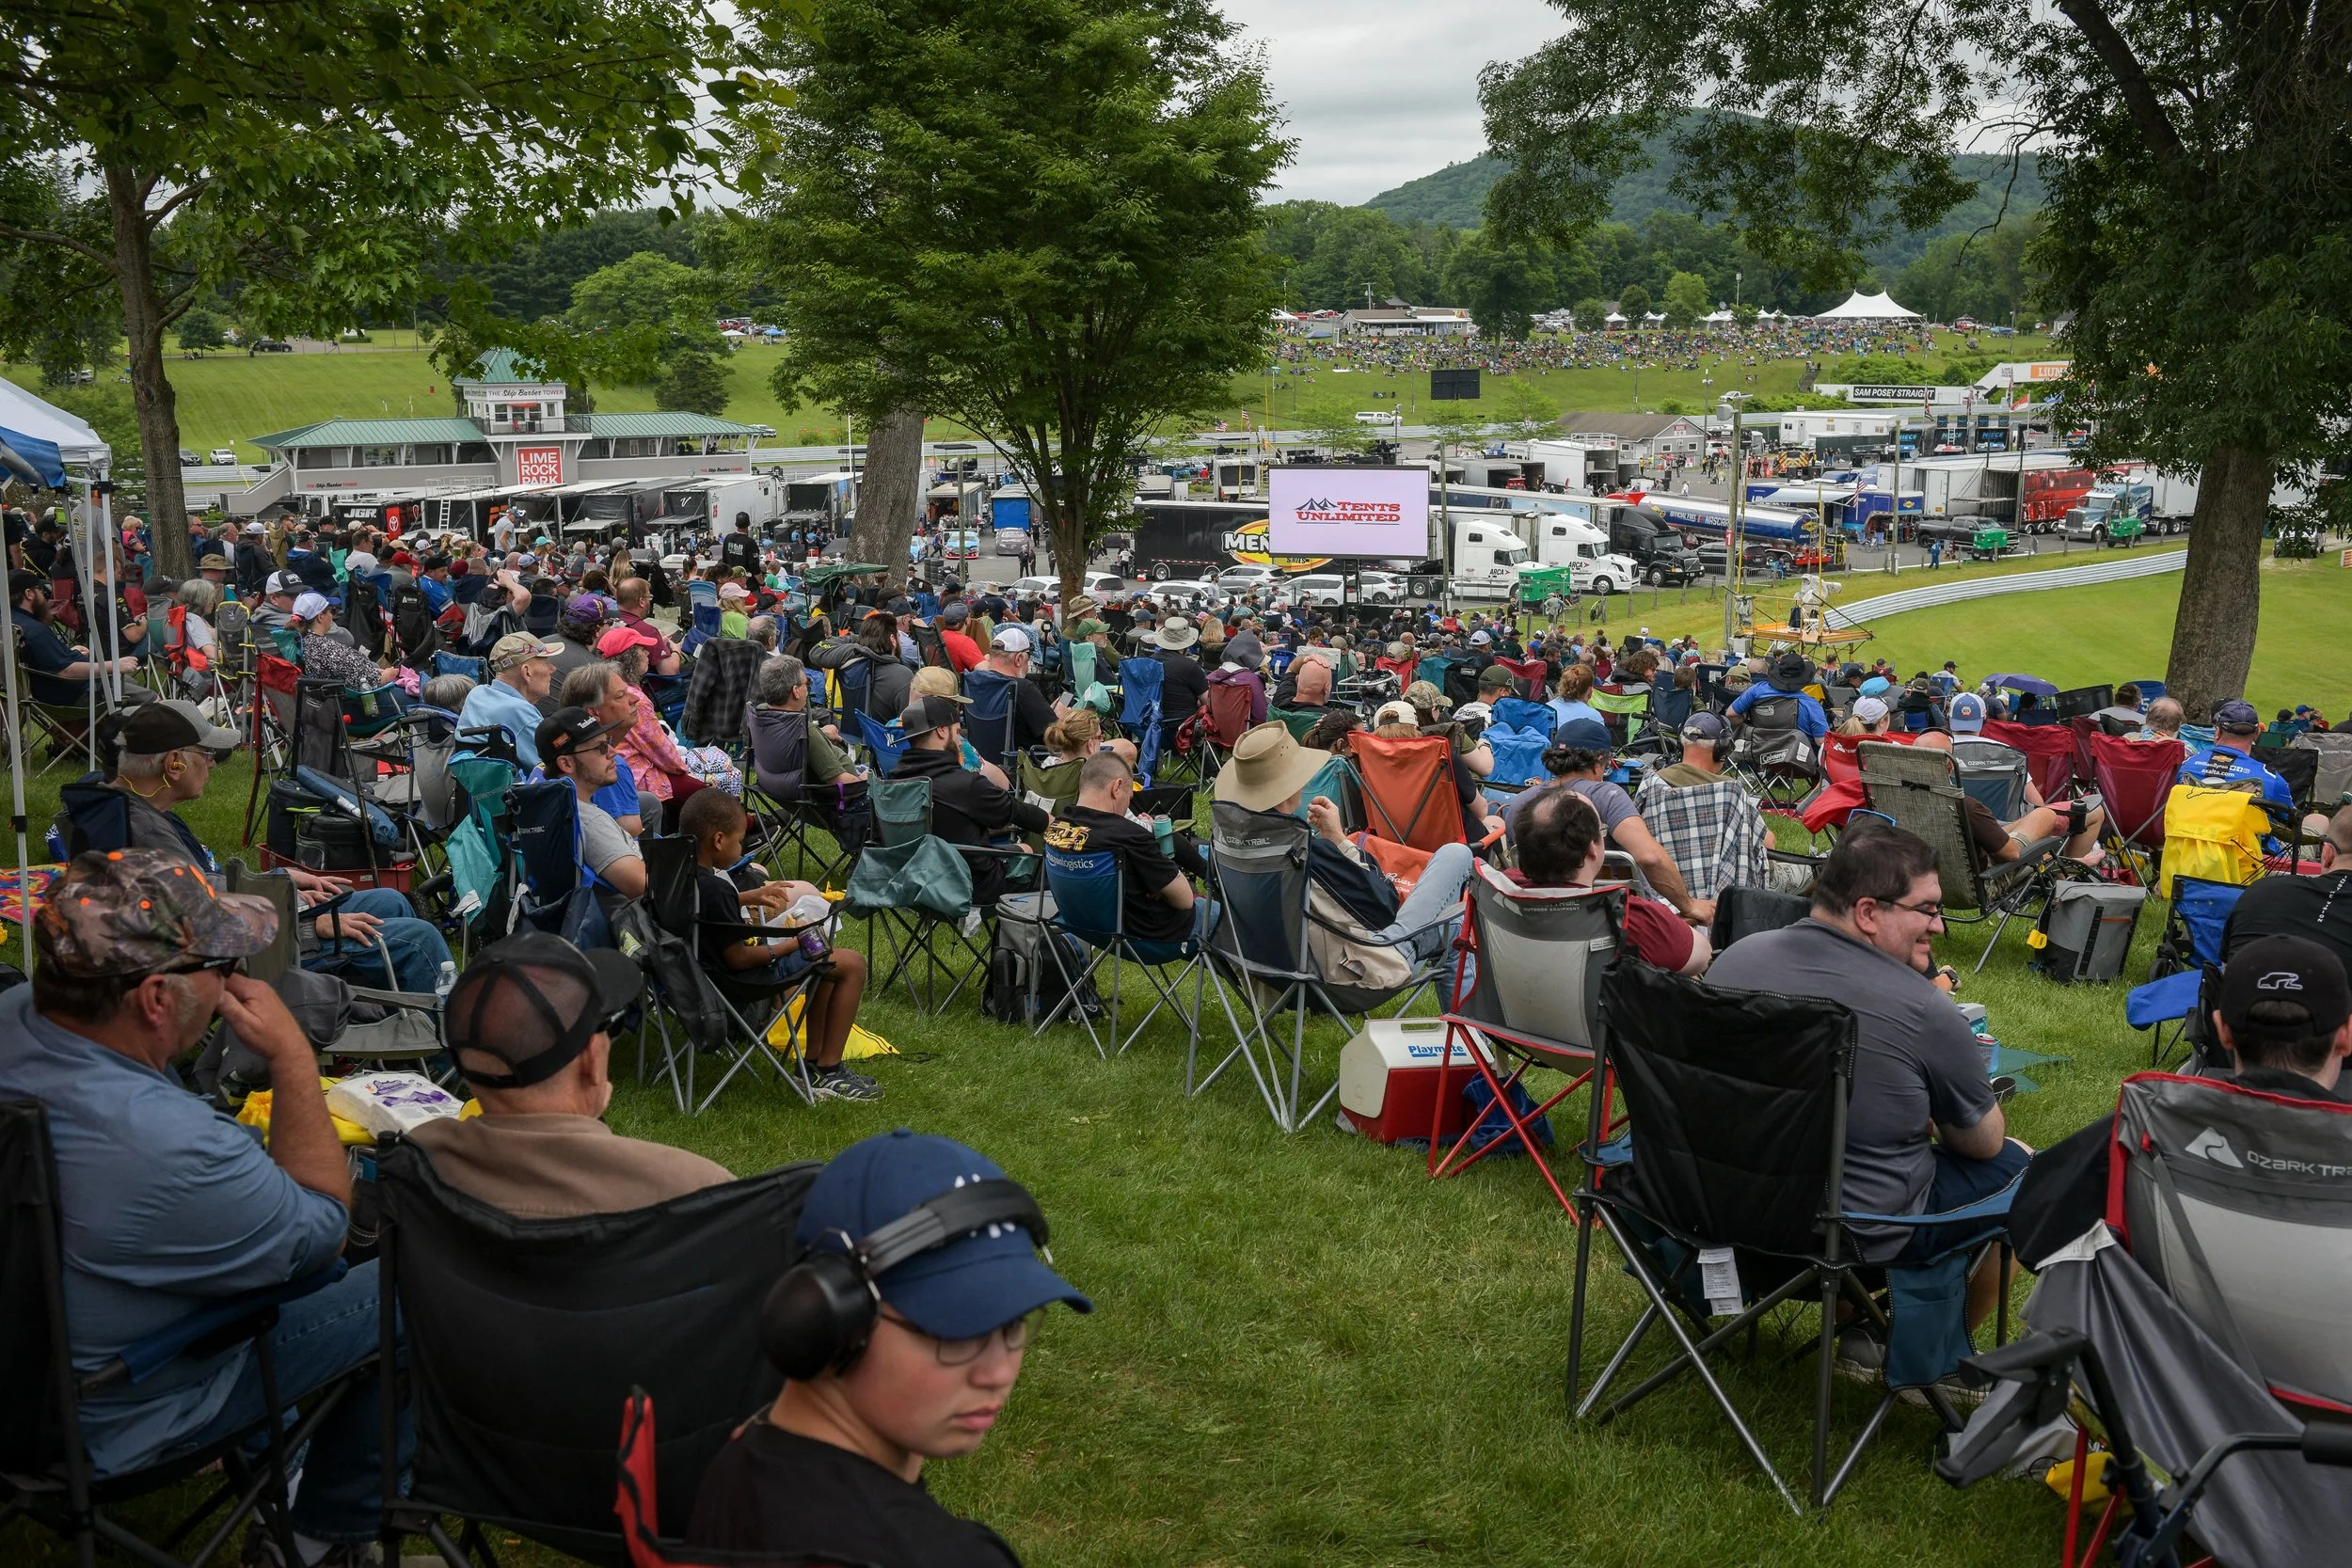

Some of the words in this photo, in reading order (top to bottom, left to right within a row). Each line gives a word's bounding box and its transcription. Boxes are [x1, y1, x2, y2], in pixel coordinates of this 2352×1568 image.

[501, 389, 516, 399] Skip
[1872, 388, 1896, 397] POSEY
[520, 452, 558, 464] LIME
[521, 464, 558, 476] ROCK
[522, 475, 558, 484] PARK
[1337, 501, 1400, 512] TENTS
[1296, 511, 1401, 522] UNLIMITED
[1670, 511, 1688, 519] OFFICIAL
[1705, 515, 1730, 527] NASCAR
[1726, 532, 1732, 546] 1
[1407, 1045, 1464, 1053] Playmte
